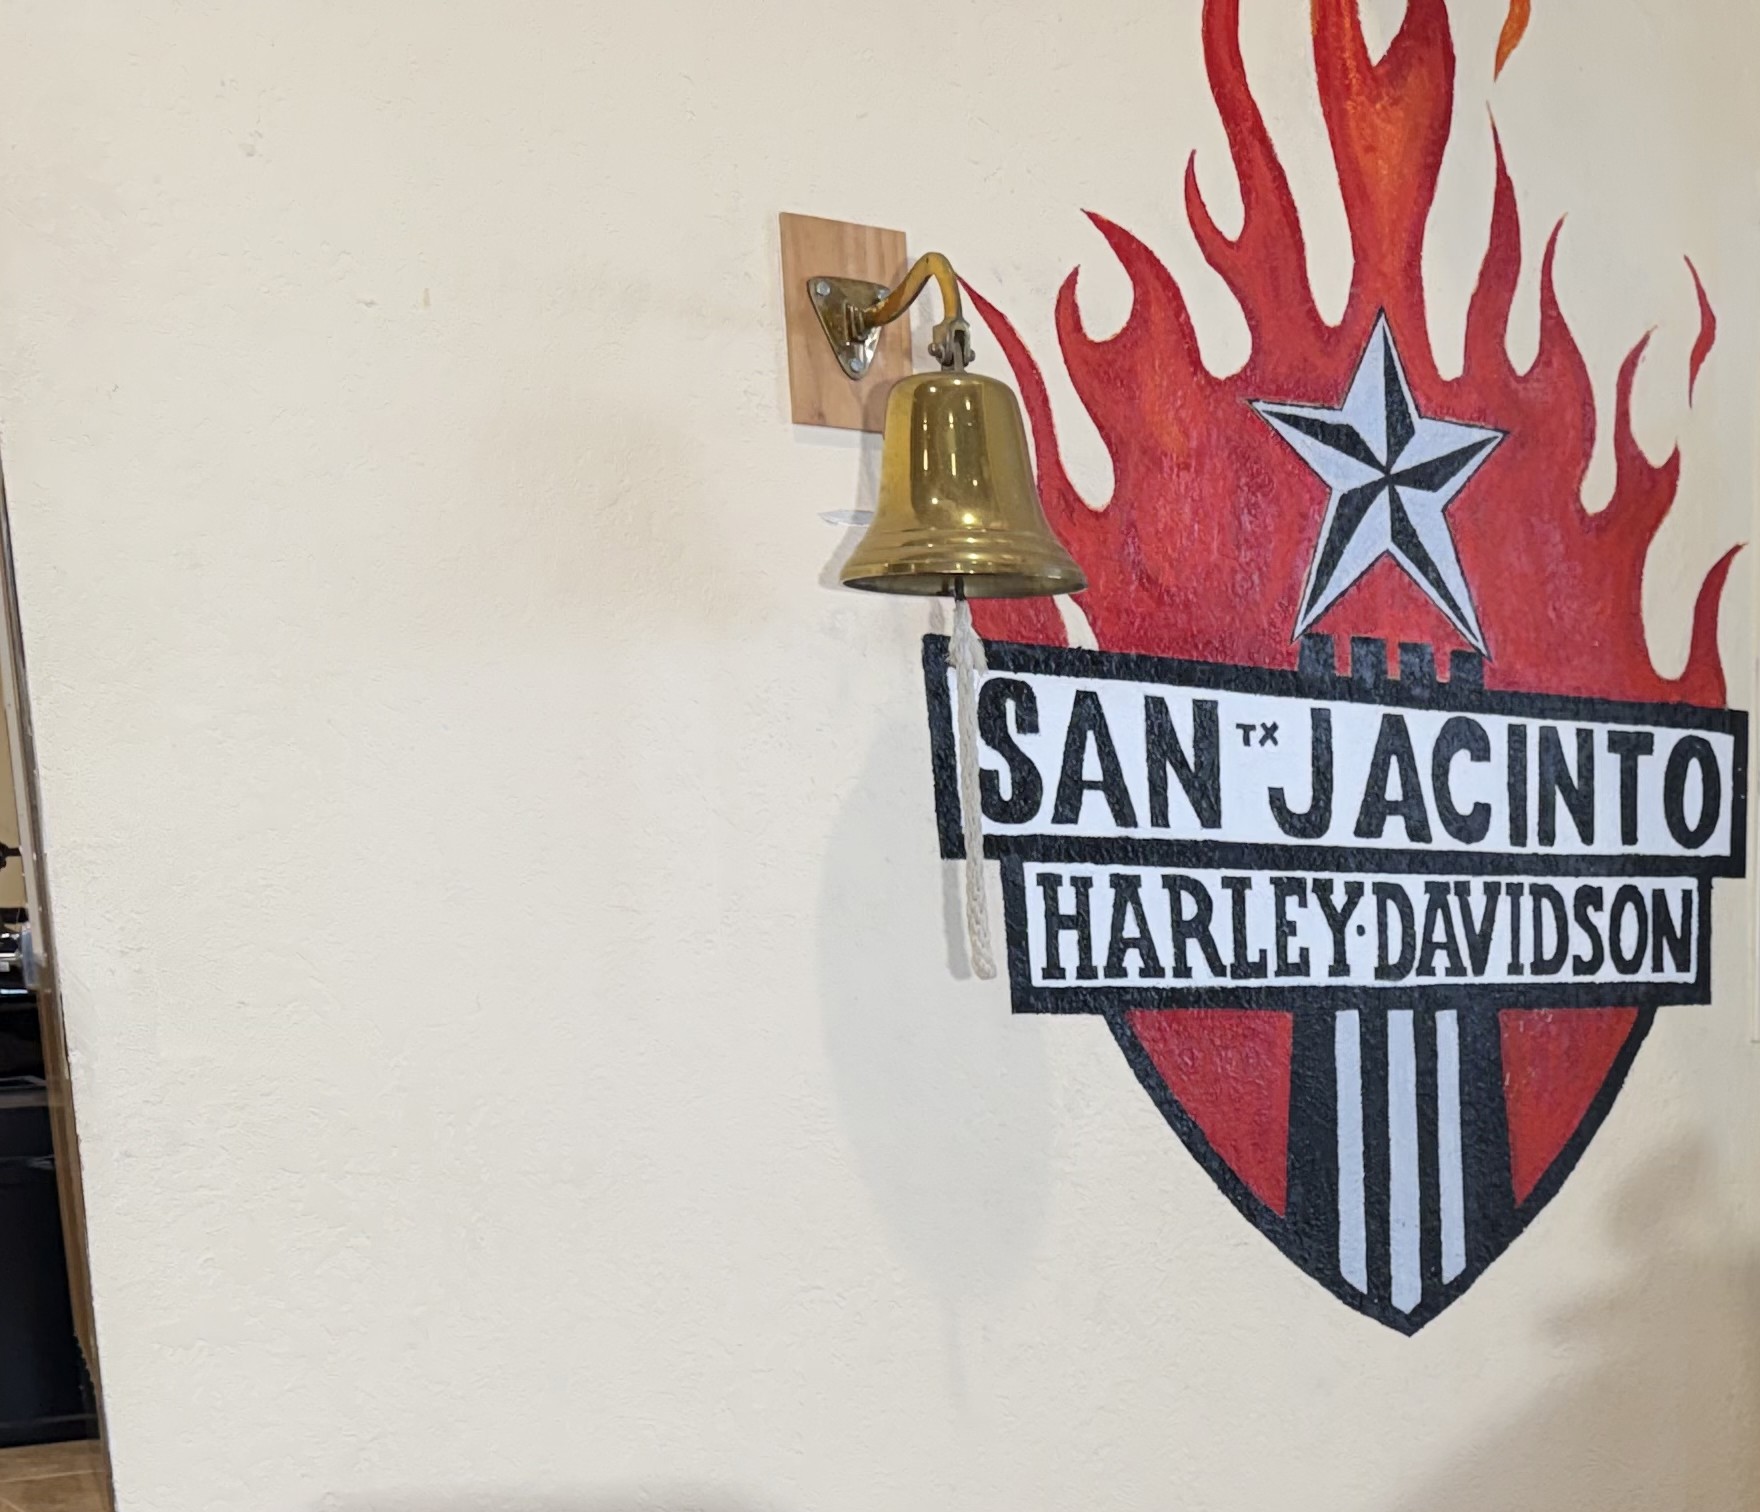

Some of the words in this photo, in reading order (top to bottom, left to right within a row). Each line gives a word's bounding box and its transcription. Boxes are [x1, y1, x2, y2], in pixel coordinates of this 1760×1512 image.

[979, 678, 1223, 829] SAN
[1236, 723, 1279, 747] TX
[1268, 708, 1721, 850] JACINTO
